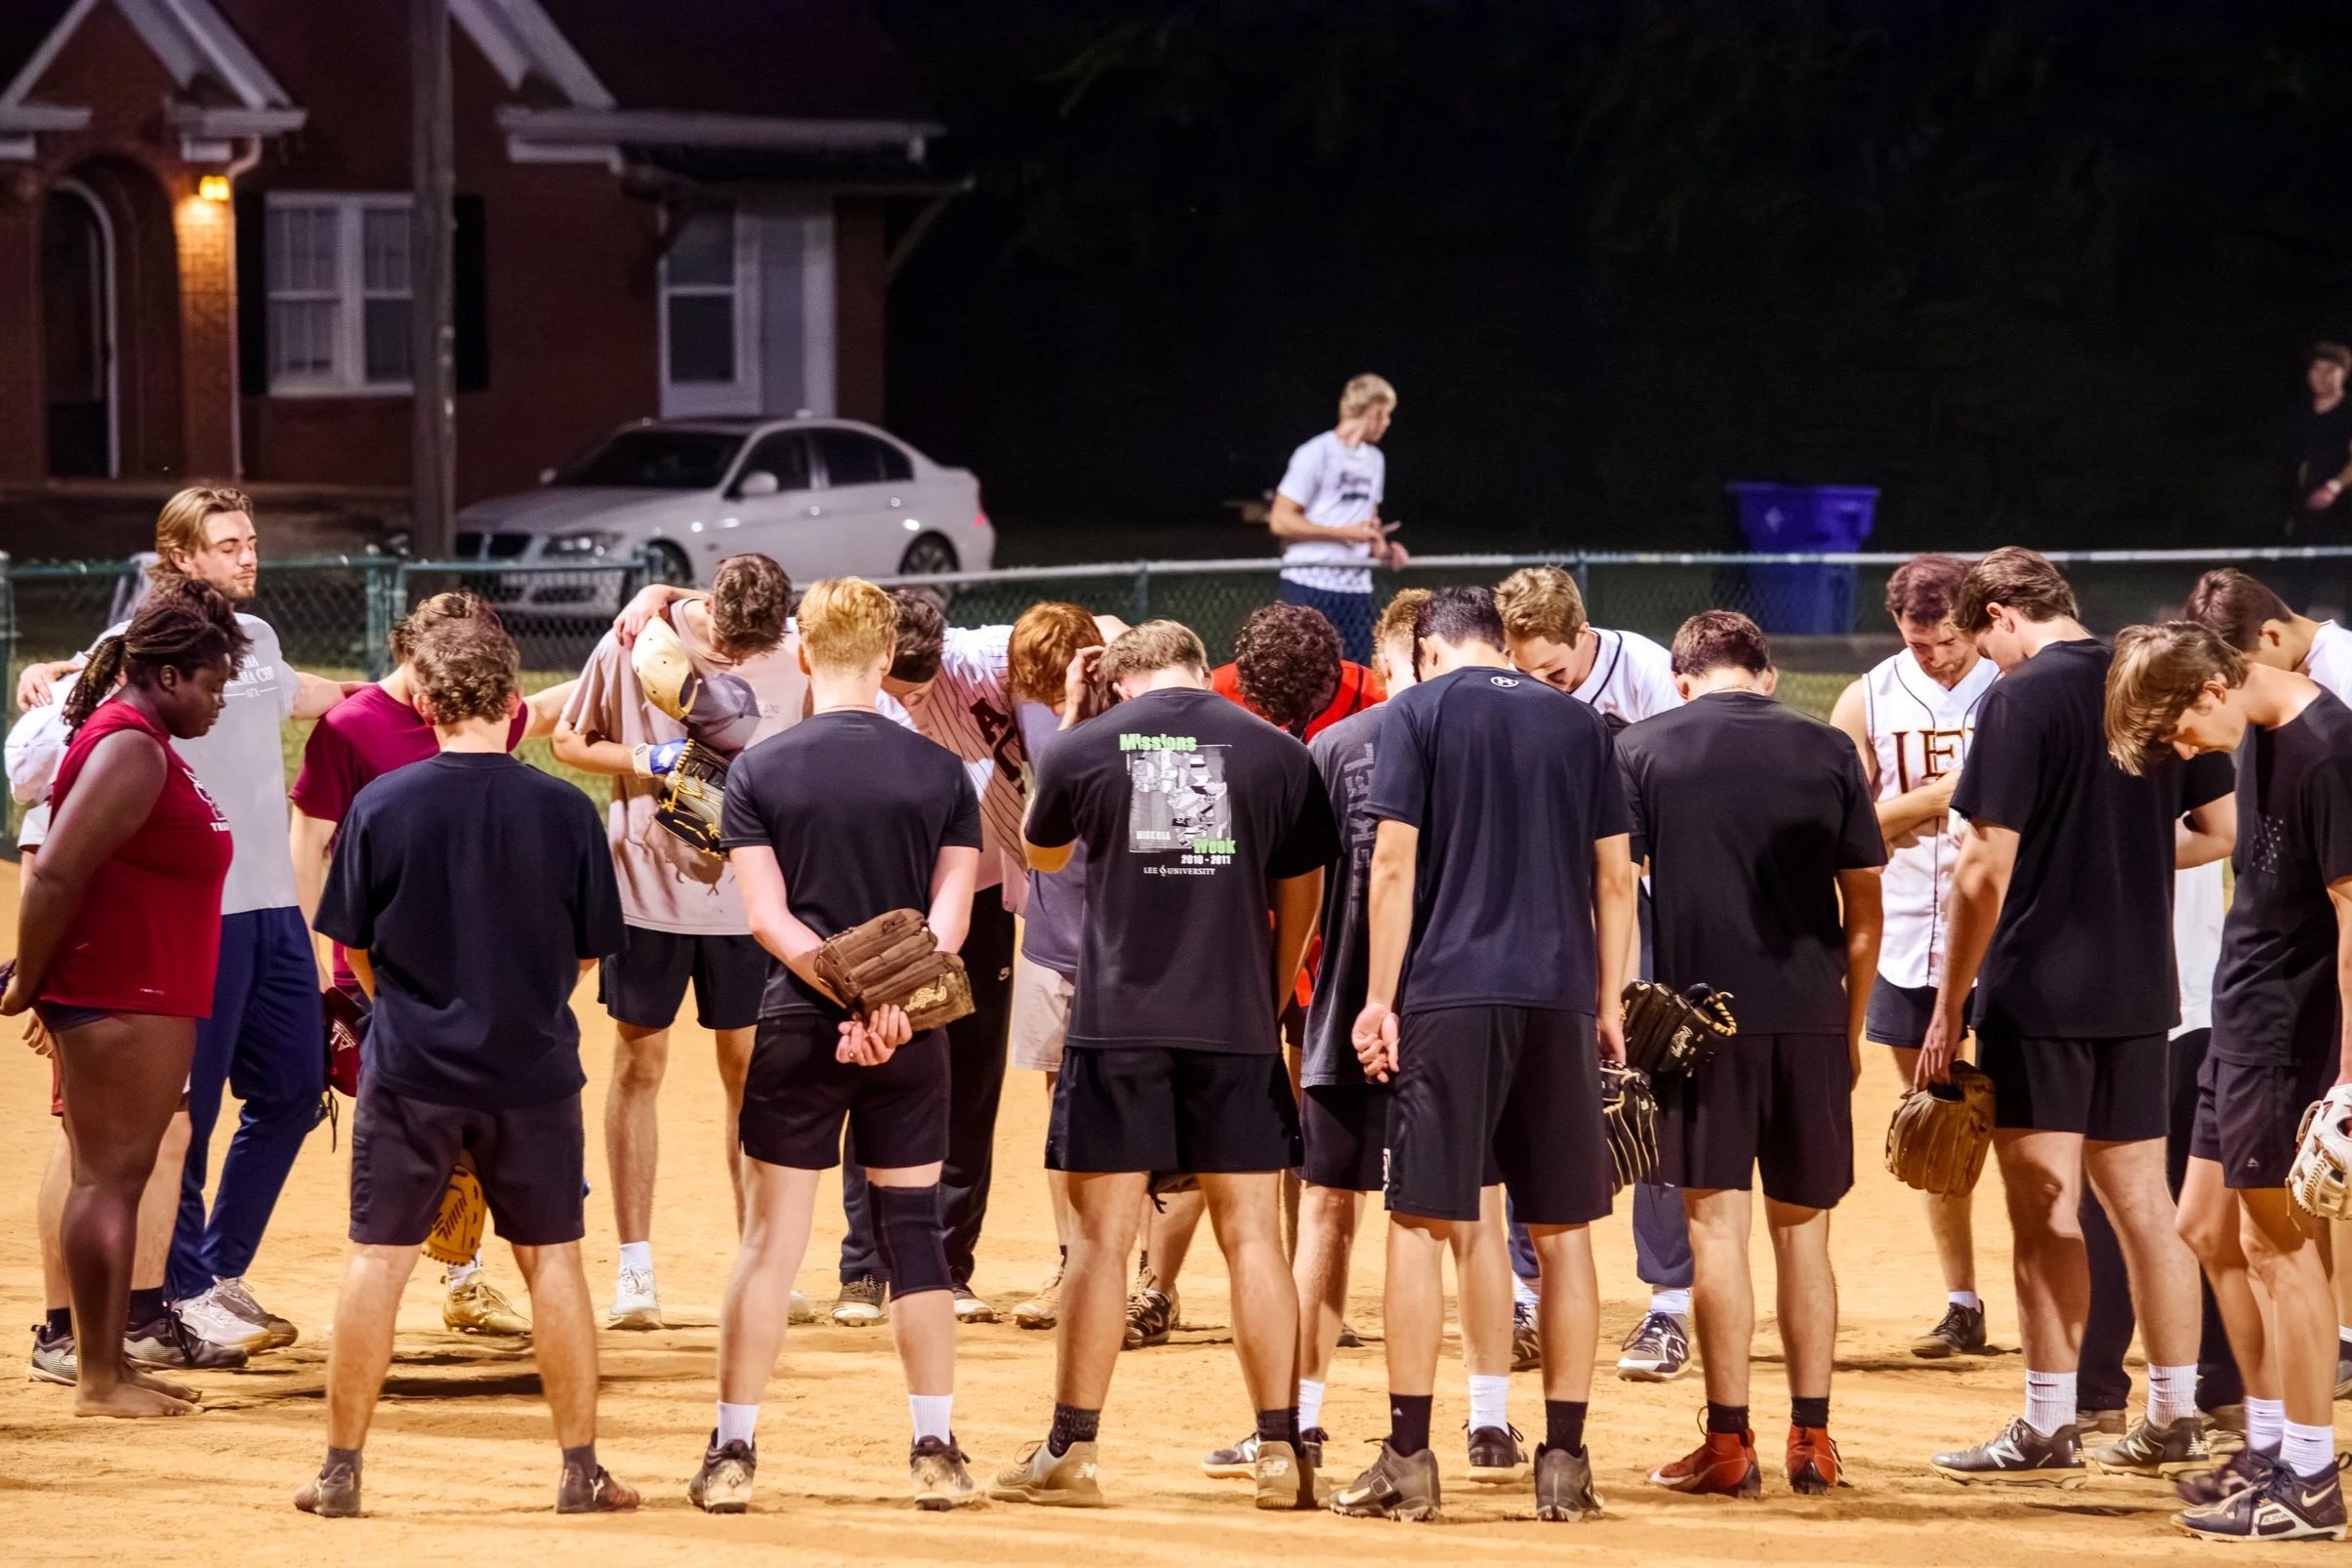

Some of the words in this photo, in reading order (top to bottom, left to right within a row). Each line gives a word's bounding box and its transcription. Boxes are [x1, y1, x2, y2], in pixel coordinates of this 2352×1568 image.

[1120, 733, 1197, 751] Missions
[1193, 837, 1236, 854] Week
[1210, 854, 1231, 864] 2011
[1167, 866, 1216, 875] UNIVERSITY
